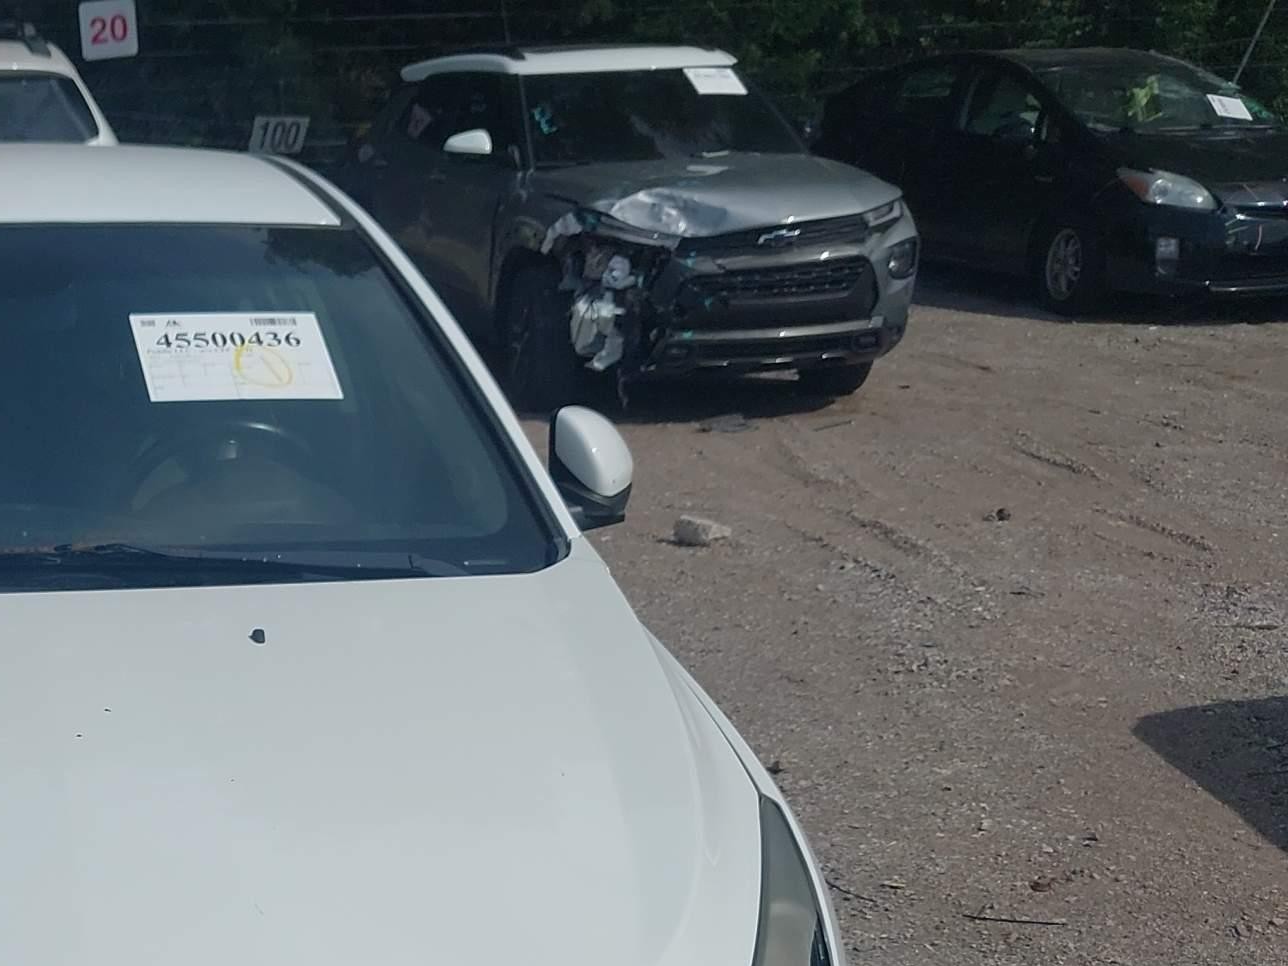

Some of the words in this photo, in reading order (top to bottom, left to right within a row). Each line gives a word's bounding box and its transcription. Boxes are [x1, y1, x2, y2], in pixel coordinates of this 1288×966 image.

[90, 15, 128, 45] 20
[263, 121, 301, 150] 100
[156, 332, 302, 349] 45500436
